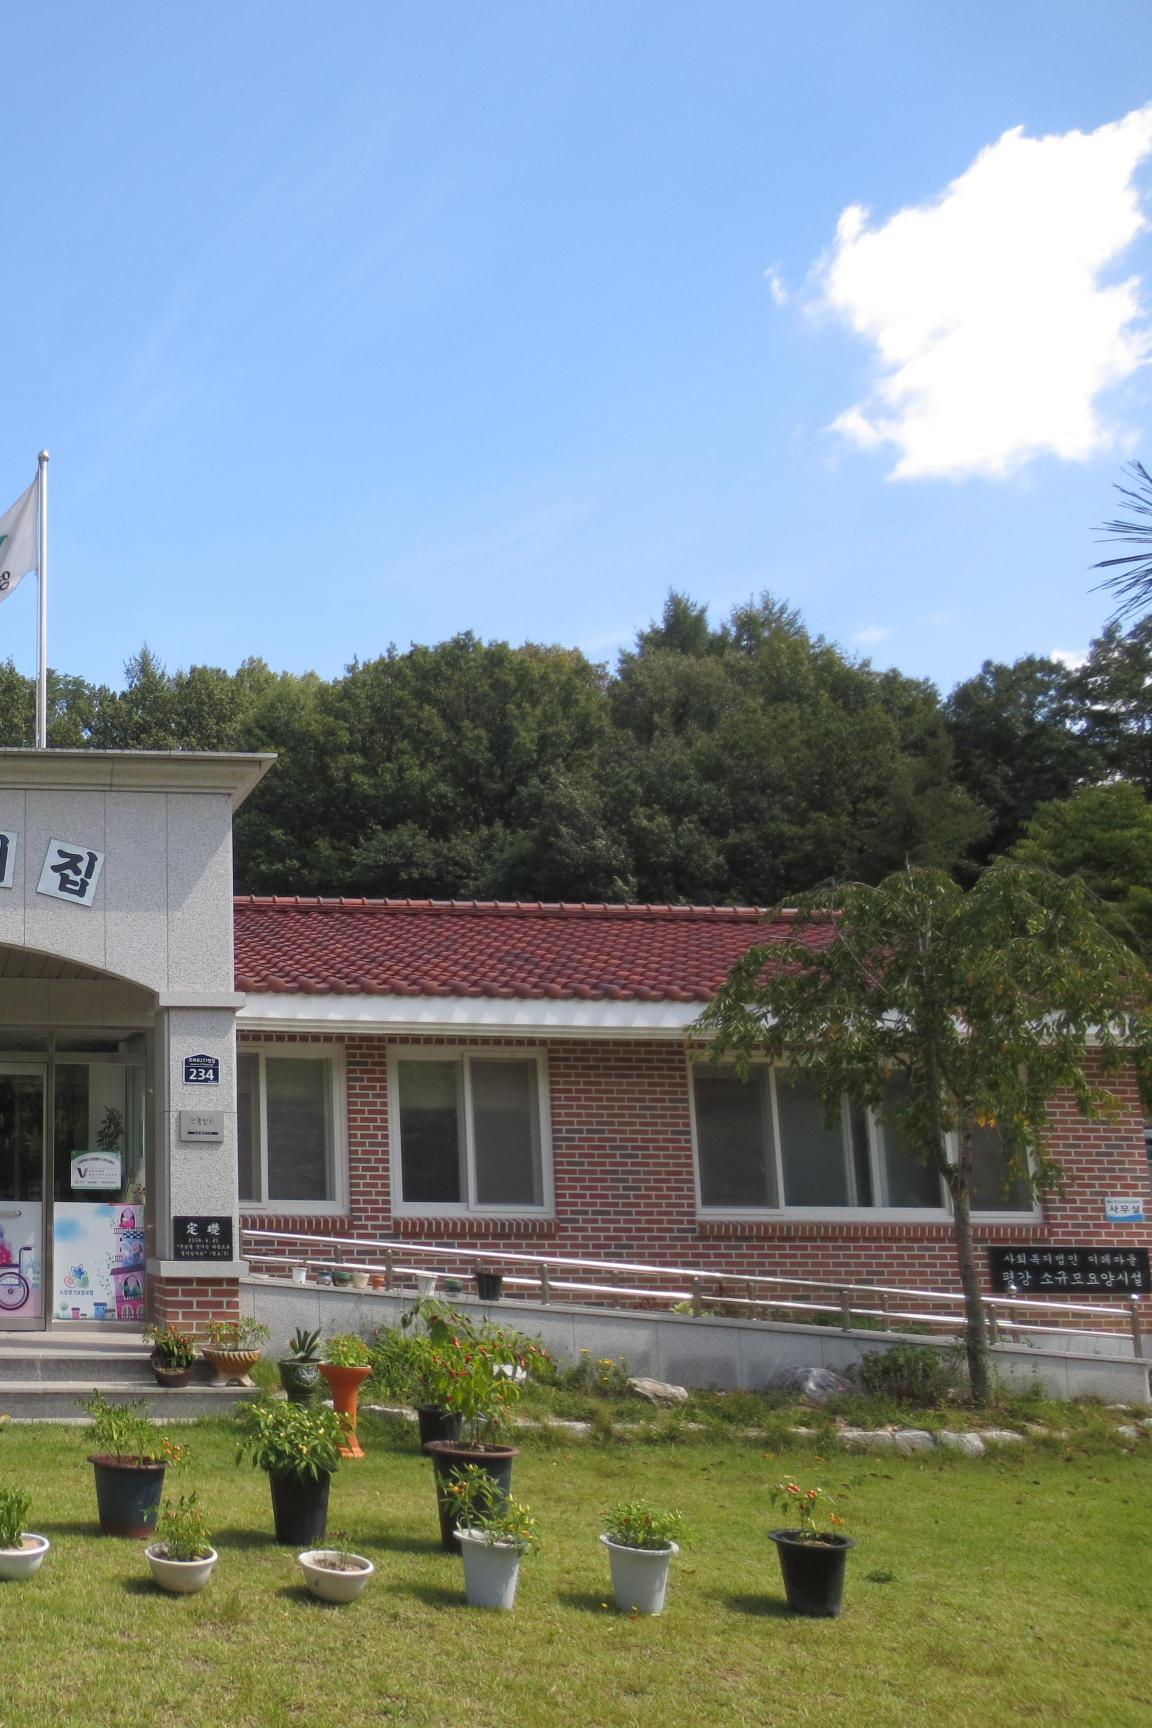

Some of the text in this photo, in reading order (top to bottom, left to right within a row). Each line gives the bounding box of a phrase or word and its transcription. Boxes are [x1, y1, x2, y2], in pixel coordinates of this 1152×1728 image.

[189, 1068, 214, 1081] 234
[1110, 1205, 1139, 1214] 사무실
[1003, 1252, 1078, 1266] 사회복지법인
[1002, 1270, 1142, 1287] 평강 소규모요양시설
